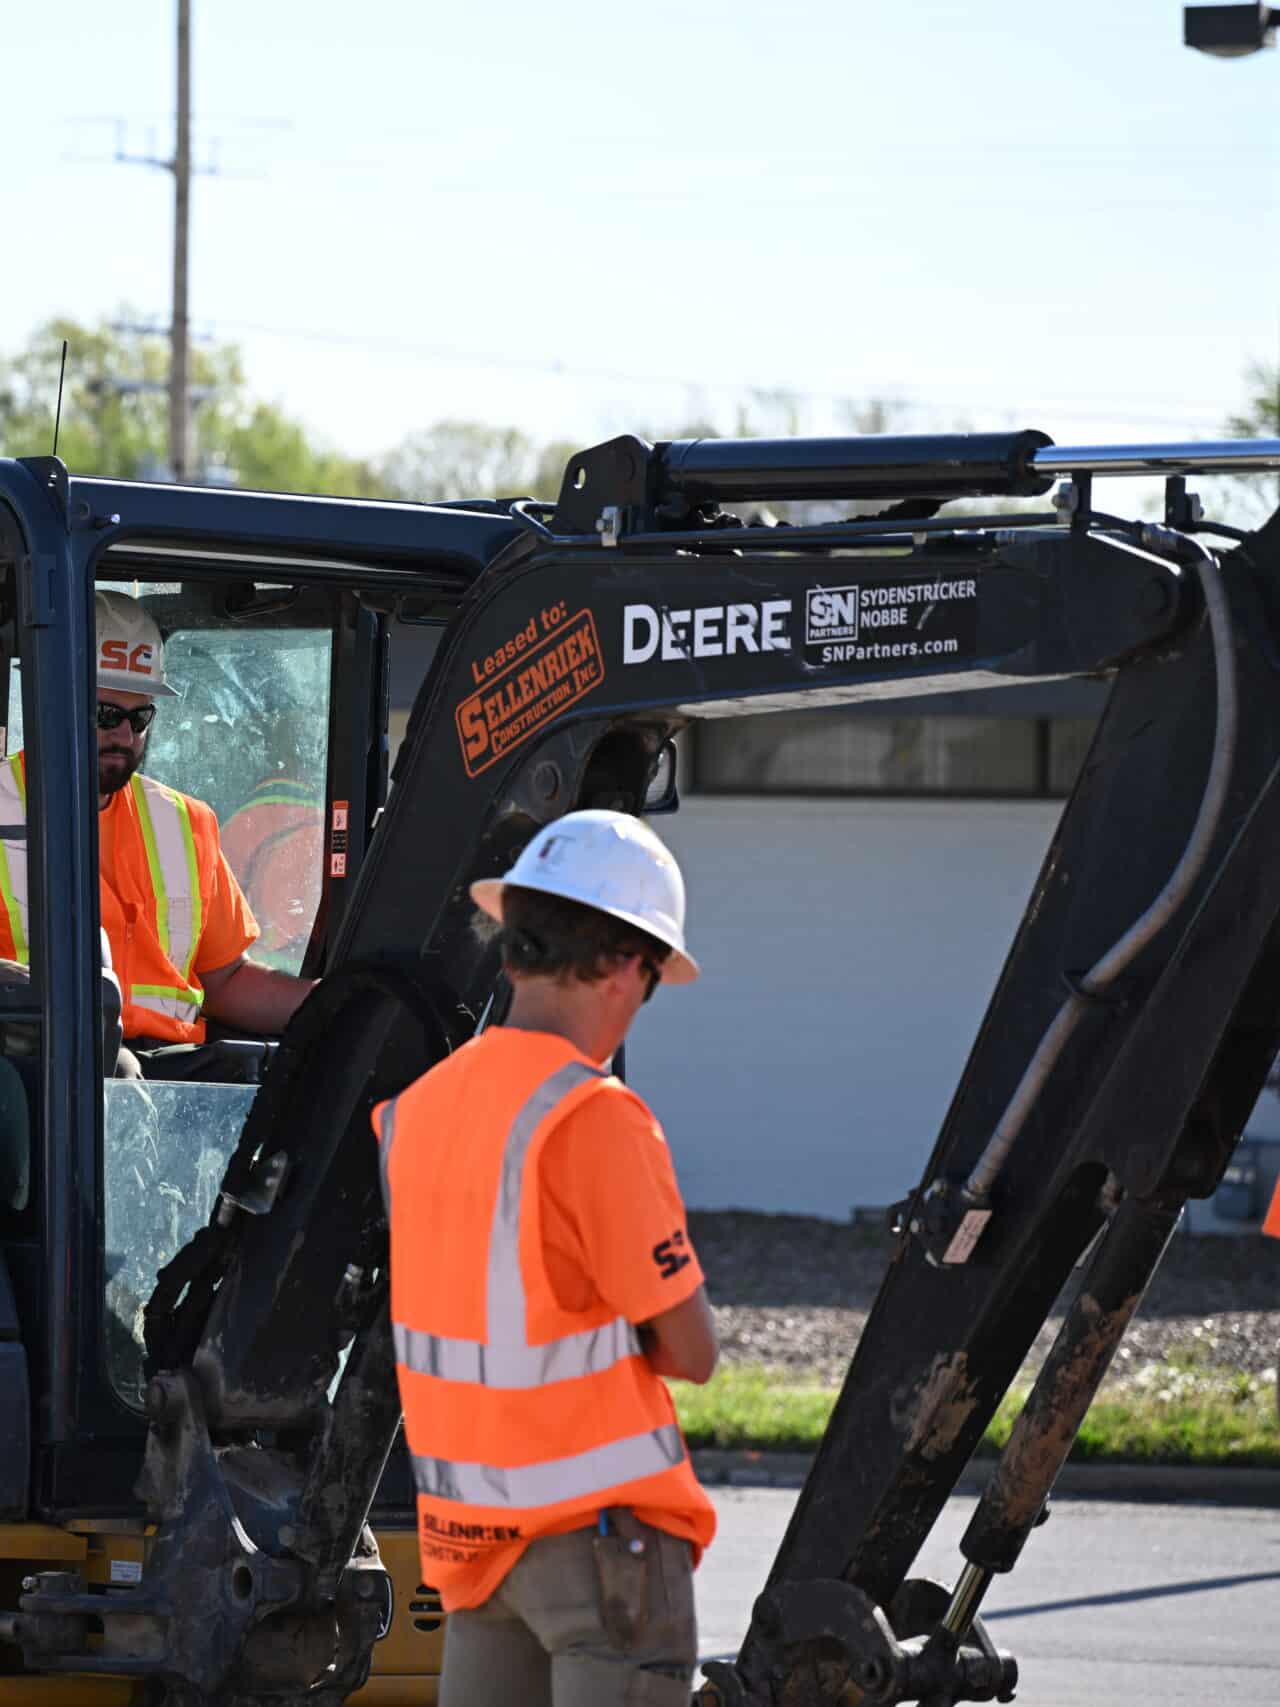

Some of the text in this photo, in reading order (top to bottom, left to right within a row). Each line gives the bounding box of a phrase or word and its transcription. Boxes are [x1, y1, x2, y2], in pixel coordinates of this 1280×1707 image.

[861, 580, 976, 607] SYDENSTRICKER
[810, 592, 855, 627] SN
[861, 608, 908, 628] NOBBE
[472, 600, 567, 684] Leased to:
[623, 600, 792, 664] DEERE
[810, 626, 854, 638] PARTNERS
[822, 639, 958, 662] SNPartners.com
[461, 624, 595, 760] SELLENRIEK
